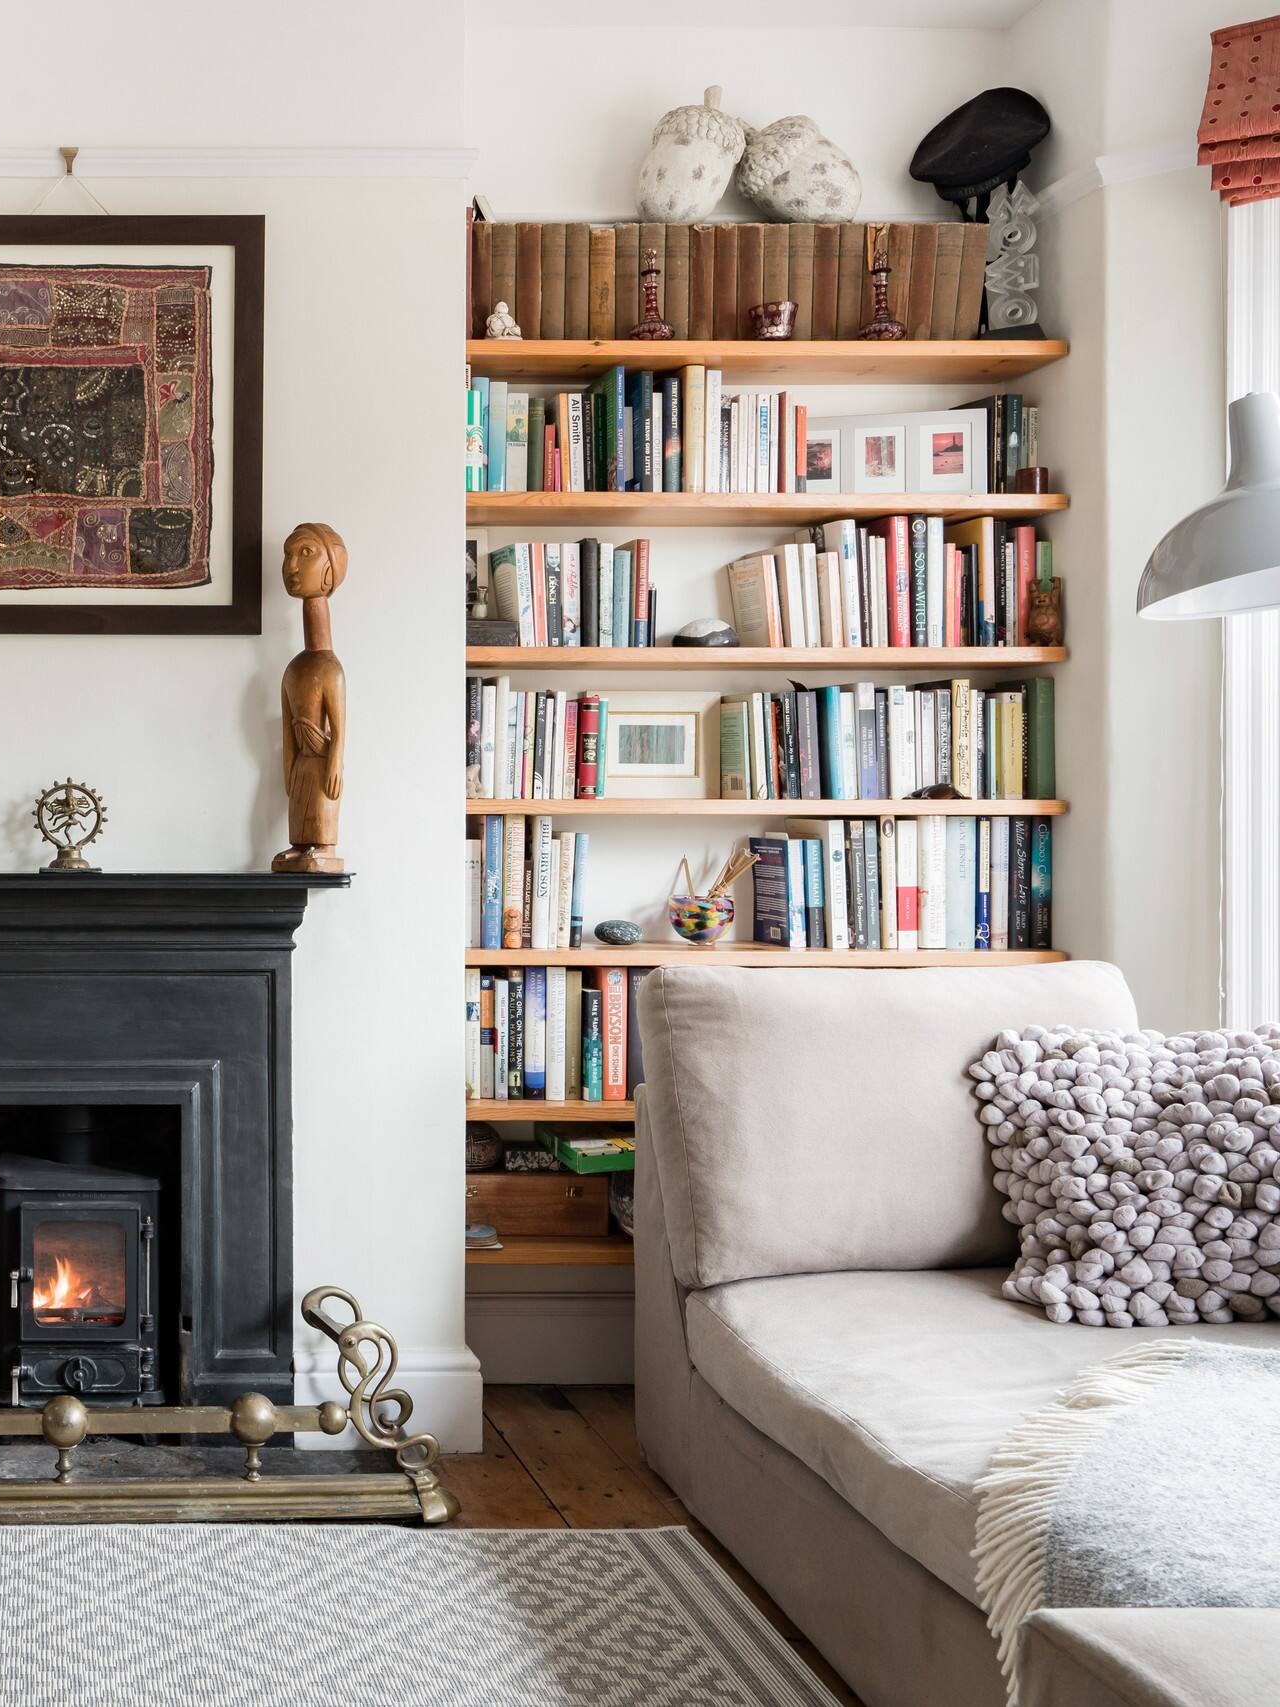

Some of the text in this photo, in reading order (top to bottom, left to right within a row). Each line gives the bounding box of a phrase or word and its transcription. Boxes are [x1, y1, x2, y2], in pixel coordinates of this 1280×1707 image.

[572, 399, 580, 444] Ali Smith
[915, 552, 925, 577] SON
[915, 591, 925, 631] WITCH
[540, 853, 549, 897] BRYSON
[517, 1020, 522, 1031] ON
[609, 994, 621, 1045] BRYSON
